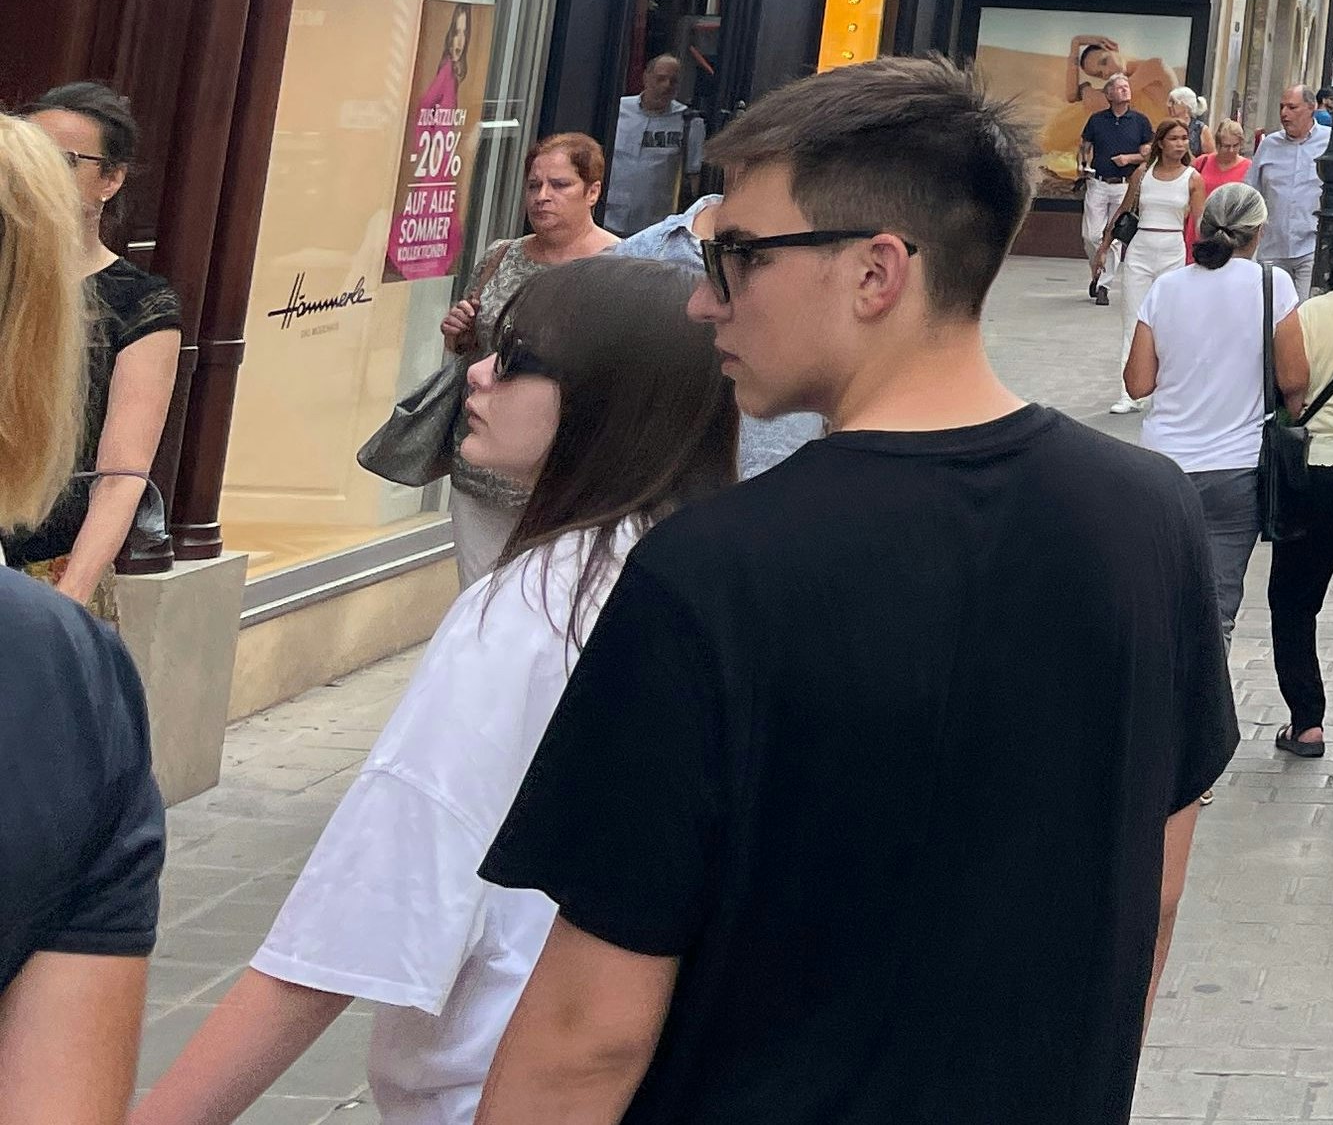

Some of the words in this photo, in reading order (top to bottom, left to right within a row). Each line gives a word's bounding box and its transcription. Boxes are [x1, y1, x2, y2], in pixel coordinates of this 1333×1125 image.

[418, 105, 467, 126] ZUSÄTZLICH
[410, 130, 462, 178] -20%
[403, 191, 428, 216] AUF
[430, 190, 456, 215] ALLE
[399, 217, 451, 243] SOMMER
